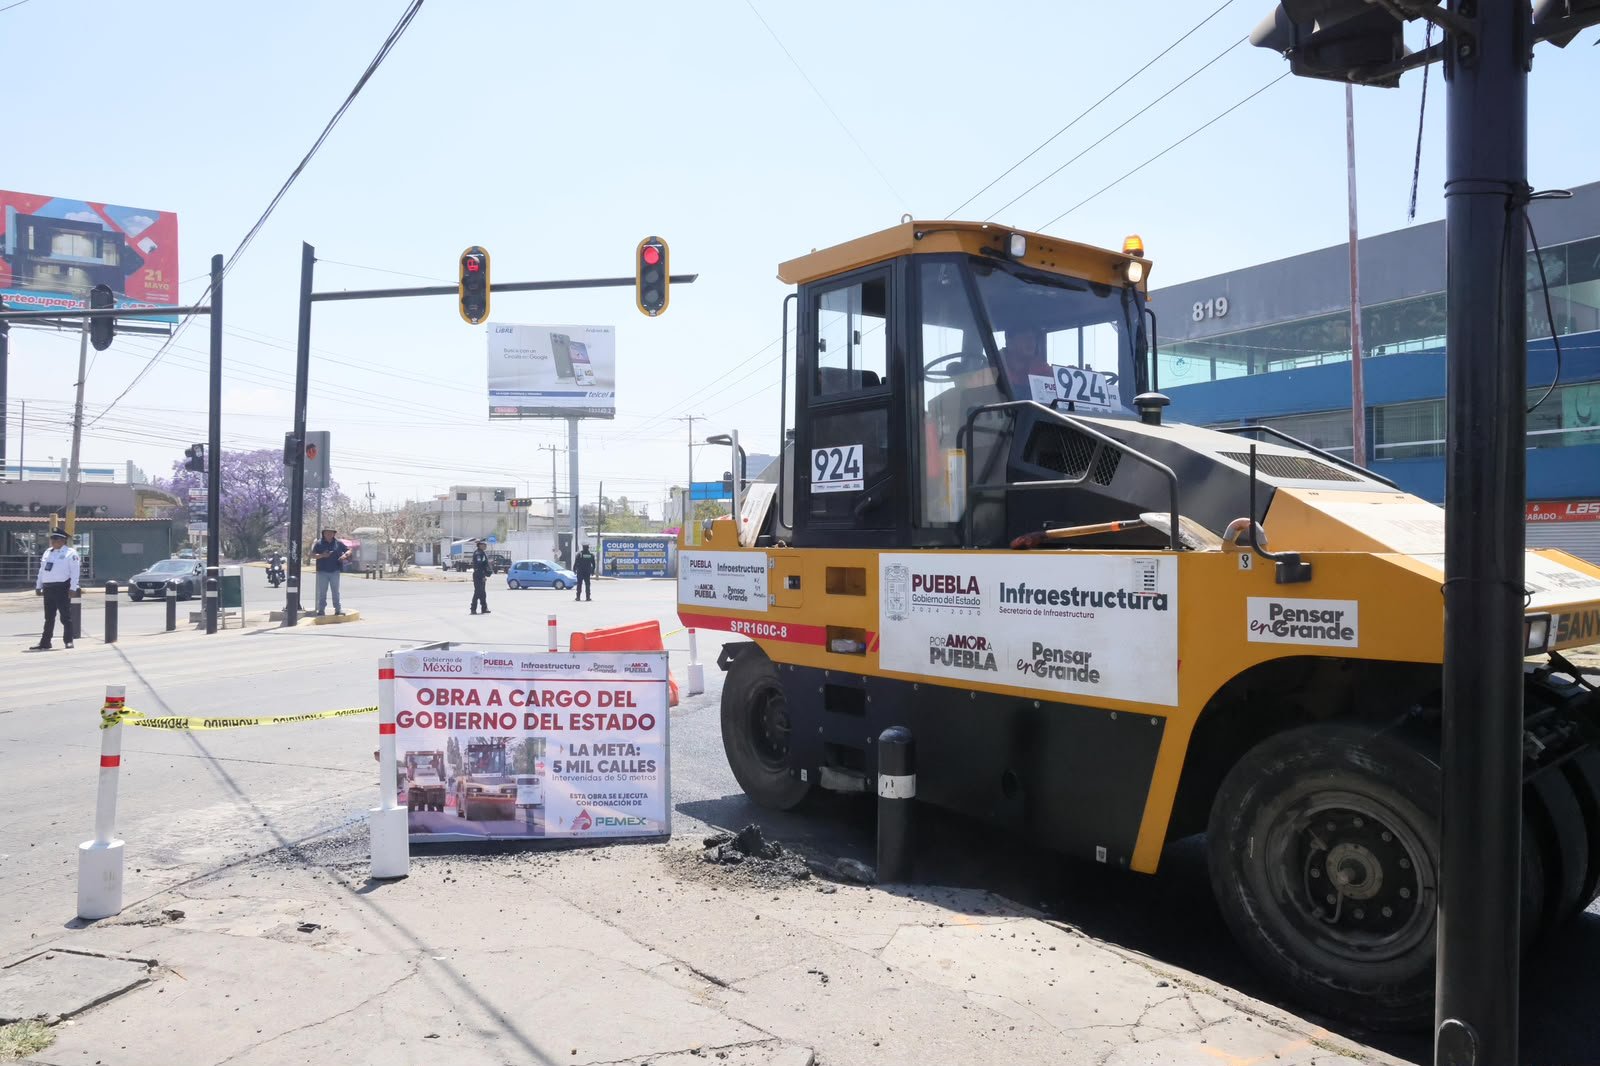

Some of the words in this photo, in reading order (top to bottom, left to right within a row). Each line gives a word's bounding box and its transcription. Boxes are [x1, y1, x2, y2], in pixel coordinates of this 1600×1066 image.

[144, 269, 162, 281] 21
[144, 281, 170, 290] MAYO
[1192, 297, 1228, 322] 819
[1057, 368, 1106, 404] 924
[815, 446, 860, 481] 924
[689, 560, 712, 569] PUEBLA
[717, 562, 765, 574] Infraestructura
[912, 574, 980, 595] PUEBLA
[694, 590, 717, 599] PUEBLA
[912, 593, 943, 604] Gobierno
[943, 596, 955, 604] del
[955, 596, 981, 606] Estado
[999, 582, 1168, 611] Infraestructura
[1033, 608, 1042, 616] de
[1043, 609, 1095, 619] Infraestructura
[1269, 603, 1344, 623] Pensar
[730, 620, 787, 638] SPR160C-8
[1250, 619, 1275, 635] en
[1271, 619, 1355, 641] Grande
[929, 636, 946, 647] POR
[945, 634, 987, 651] AMOR
[929, 647, 999, 672] PUEBLA
[1032, 641, 1092, 665] Pensar
[422, 663, 463, 673] México
[521, 661, 581, 670] Infraestructura
[1034, 659, 1101, 684] Grande
[416, 687, 482, 707] OBRA
[486, 688, 503, 707] A
[508, 689, 592, 708] CARGO
[597, 690, 637, 708] DEL
[395, 710, 518, 730] GOBIERNO
[523, 712, 564, 731] DEL
[569, 713, 656, 731] ESTADO
[569, 743, 590, 757] LA
[593, 743, 641, 757] META:
[552, 760, 562, 773] 5
[566, 760, 594, 773] MIL
[597, 760, 657, 773] CALLES
[592, 799, 631, 807] DONACIÓN
[595, 817, 647, 826] PEMEX
